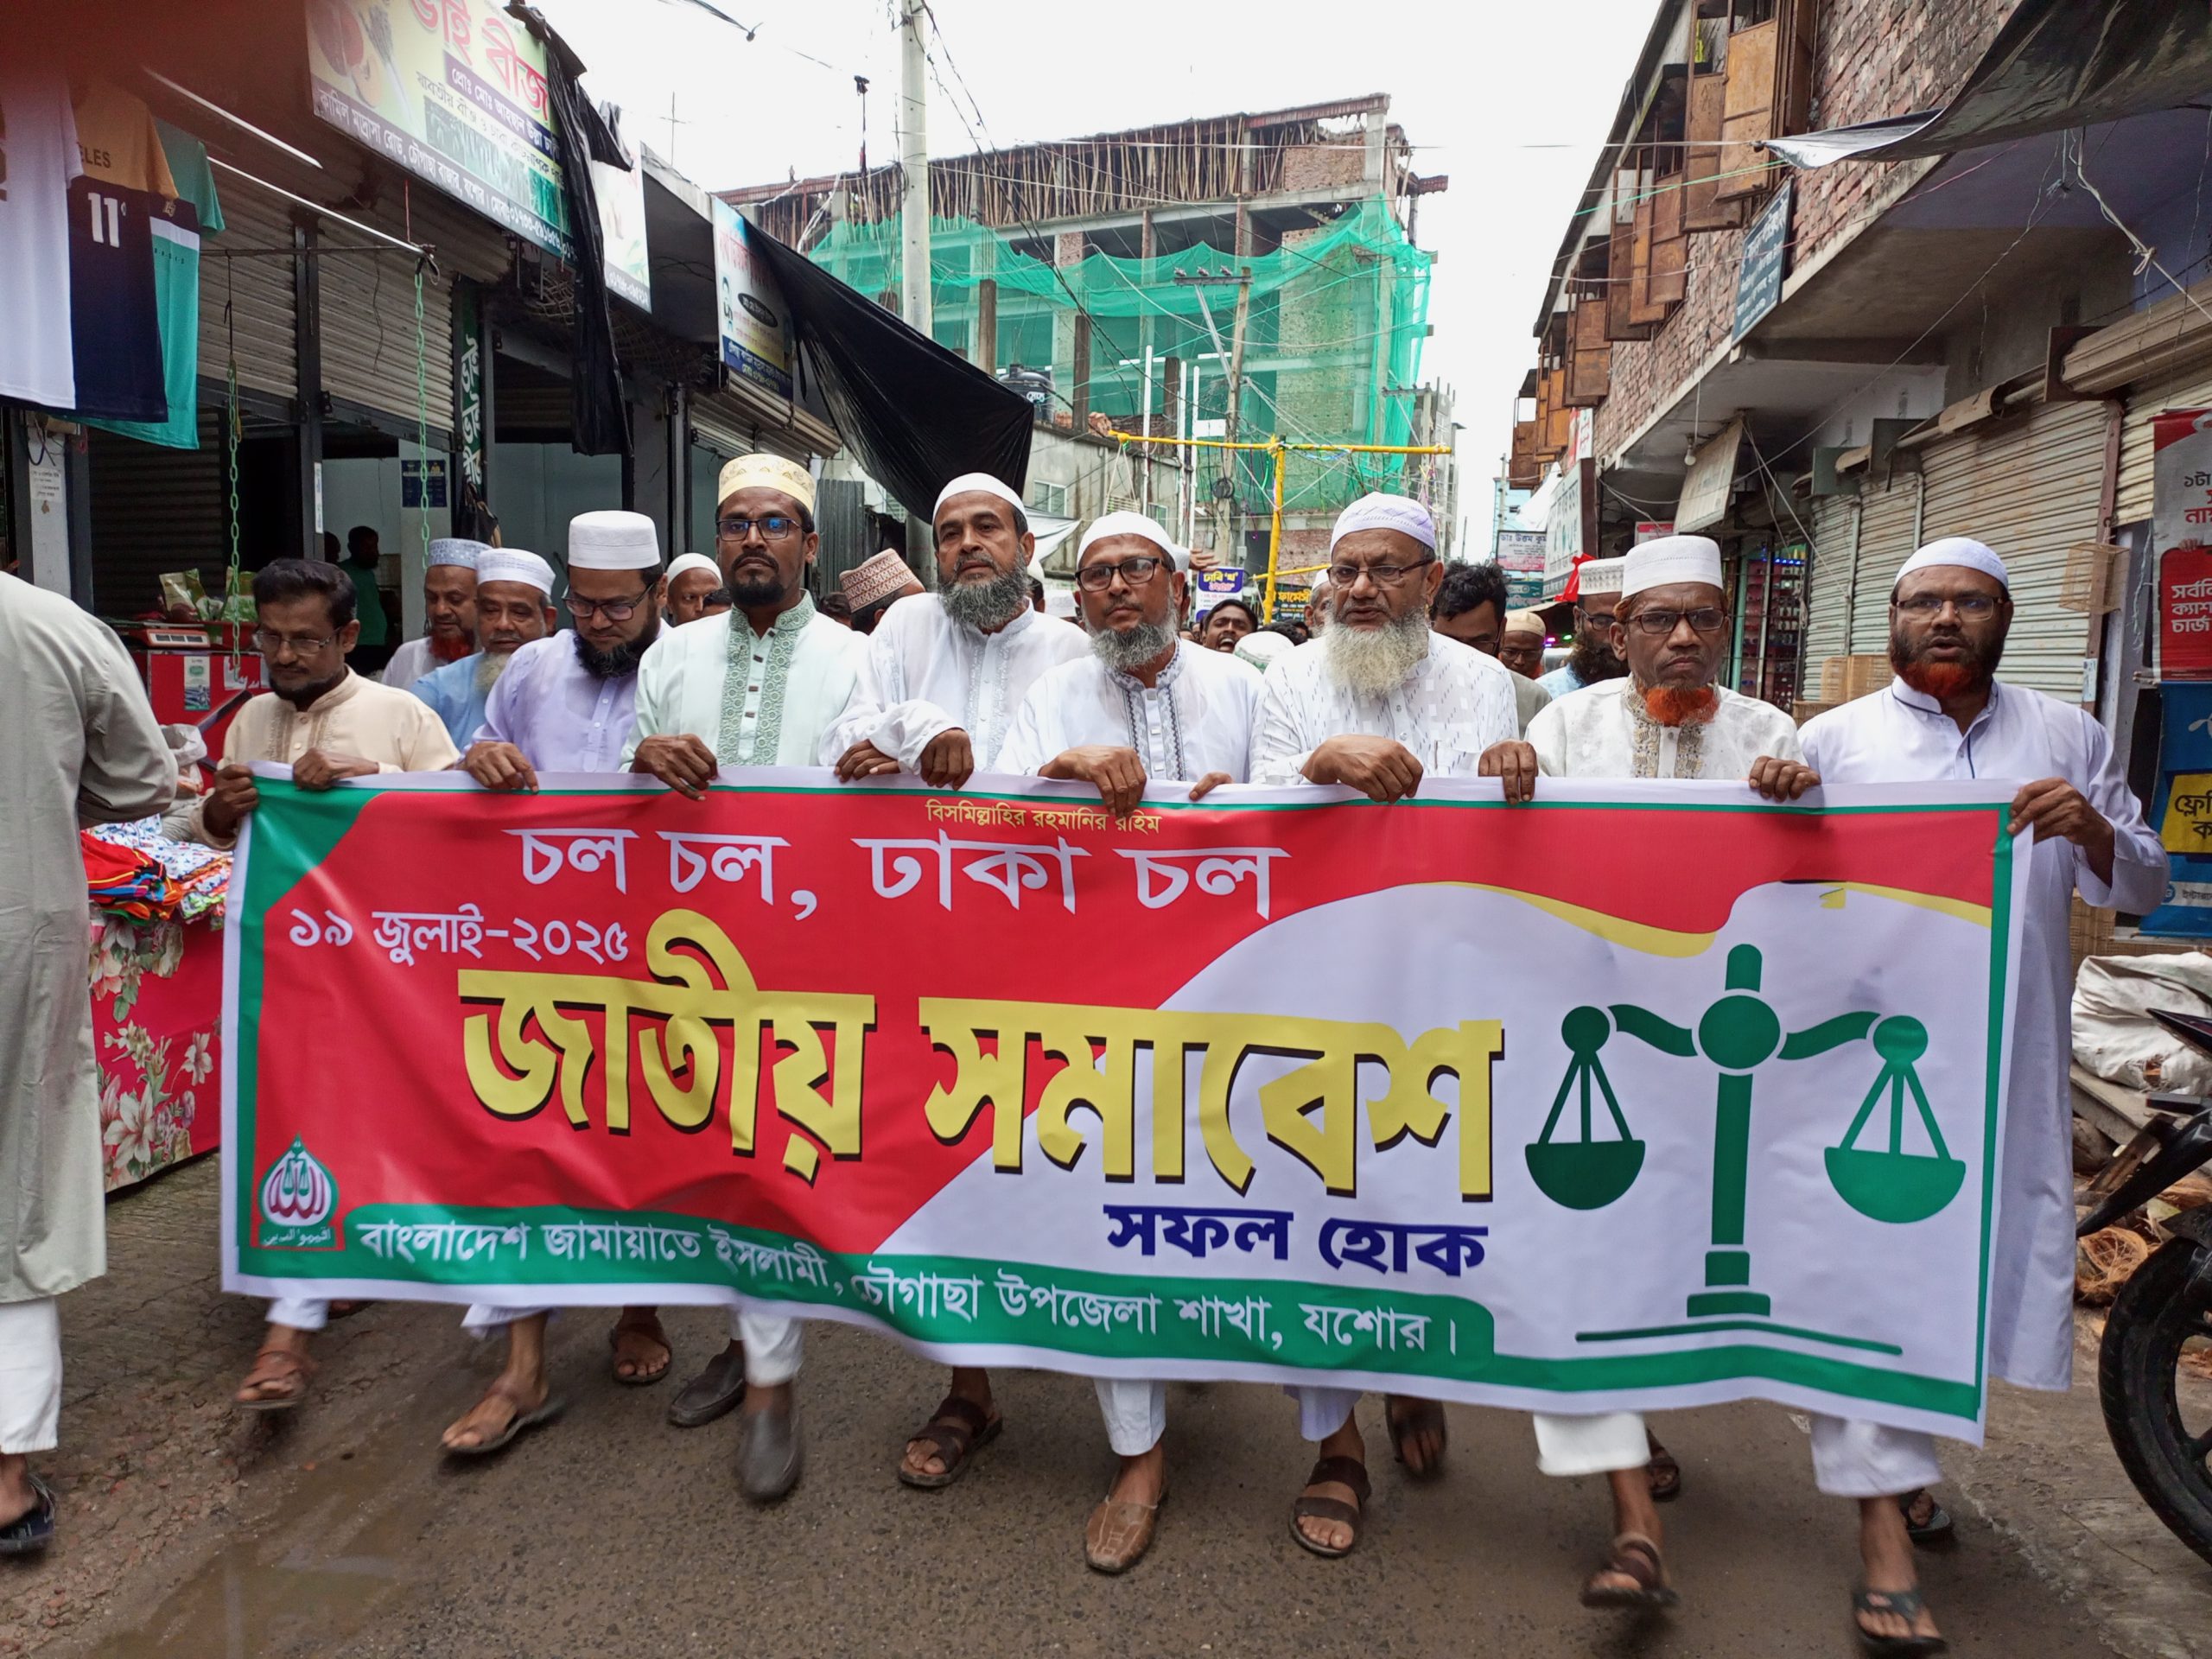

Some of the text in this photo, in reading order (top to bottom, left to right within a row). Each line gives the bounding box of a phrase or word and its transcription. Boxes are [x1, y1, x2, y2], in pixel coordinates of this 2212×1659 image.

[481, 17, 548, 121] বীজ
[88, 192, 120, 248] 11
[2170, 614, 2209, 633] চার্জ
[925, 798, 1027, 828] বিসমিল্লাহির
[1031, 807, 1109, 832] রহমানির
[501, 828, 1293, 921] চল চল, ঢাকা চল
[289, 903, 630, 967] ১৯ জুলাই-২০২৫
[457, 907, 1505, 1204] জাতীয় সমাবেশ
[1103, 1205, 1490, 1277] সফল হোক
[355, 1219, 531, 1263] বাংলাদেশ
[541, 1219, 702, 1263] জামায়াতে
[850, 1260, 985, 1324] চৌগাছা
[994, 1268, 1161, 1335] উপজেলা
[1173, 1294, 1284, 1351] শাখা,
